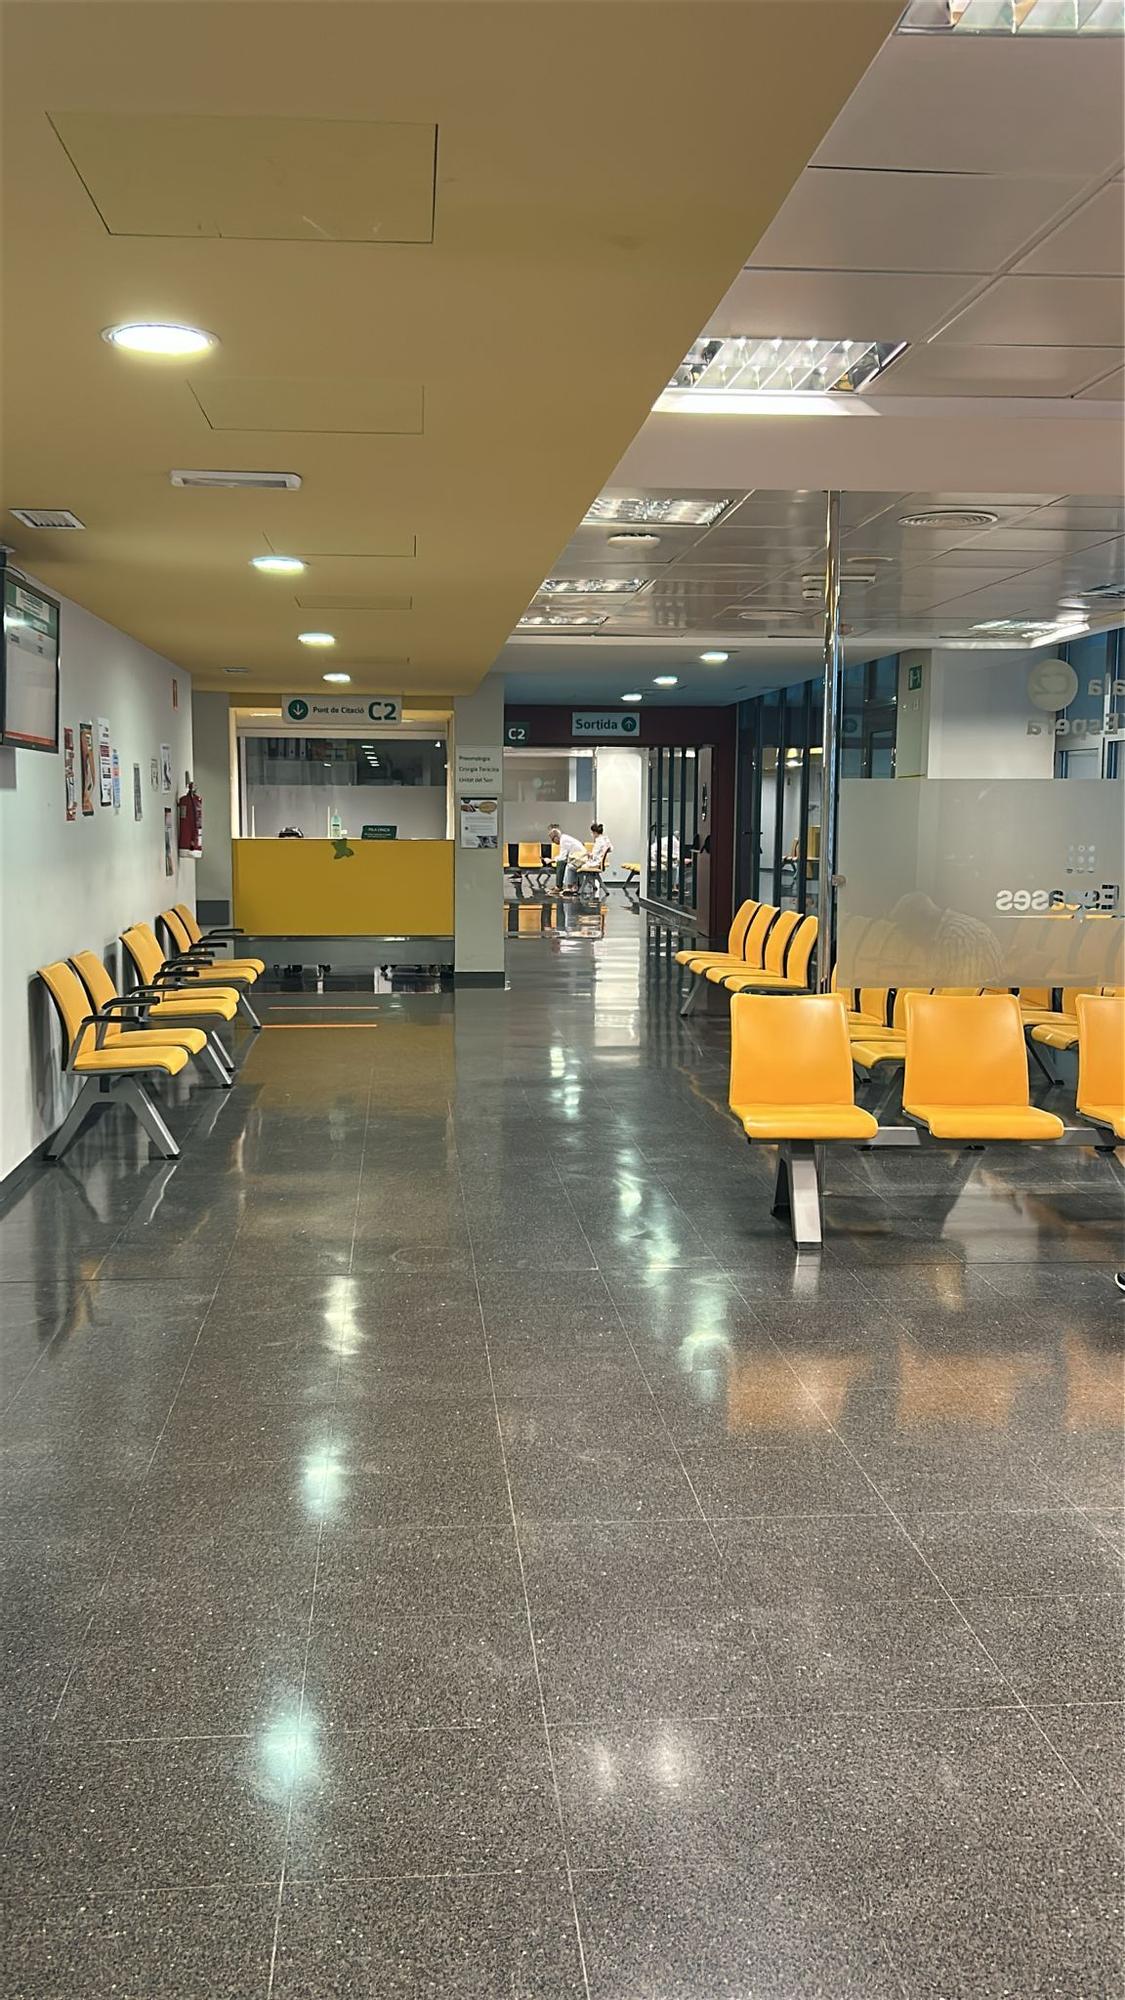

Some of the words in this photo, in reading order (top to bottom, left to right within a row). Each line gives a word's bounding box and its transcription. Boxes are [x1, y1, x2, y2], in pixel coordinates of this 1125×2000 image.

[312, 706, 330, 714] Punt
[330, 706, 340, 714] de
[341, 706, 365, 714] Citació
[368, 701, 397, 721] C2
[575, 718, 618, 731] Sortida
[508, 728, 526, 740] C2
